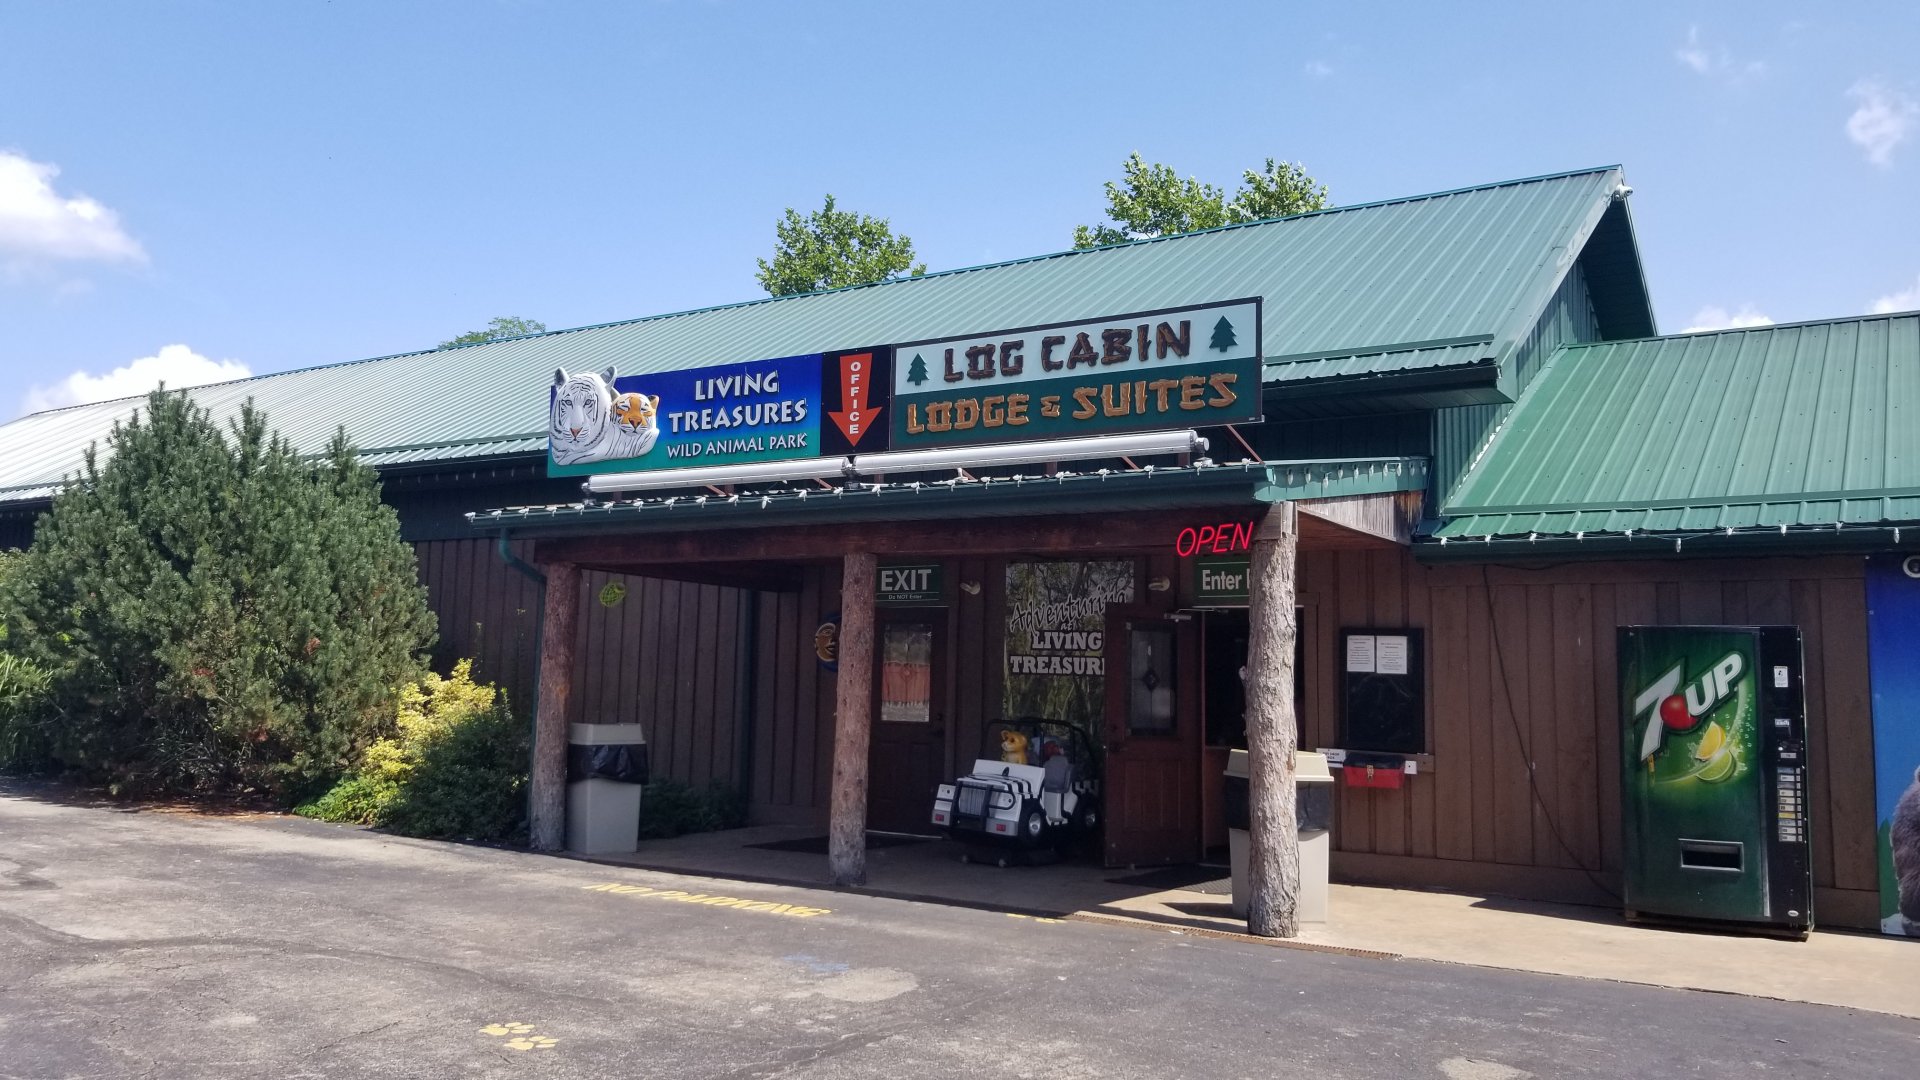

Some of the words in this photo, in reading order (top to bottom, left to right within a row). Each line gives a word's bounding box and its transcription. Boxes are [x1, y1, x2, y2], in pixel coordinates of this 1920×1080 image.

[944, 340, 1024, 383] LOG
[1042, 320, 1191, 372] CABIN
[695, 371, 779, 401] LIVING
[850, 361, 861, 434] OFFICE
[668, 398, 806, 433] TREASURES
[907, 394, 1030, 434] LODGE
[1041, 396, 1060, 417] &
[1073, 373, 1237, 419] SUITES
[667, 443, 702, 459] WILD
[706, 435, 764, 455] ANIMAL
[770, 432, 807, 450] PARK
[1176, 521, 1254, 557] OPEN
[881, 569, 932, 591] EXIT
[1202, 569, 1242, 590] Enter
[1032, 631, 1102, 650] LIVING
[1060, 620, 1073, 631] at
